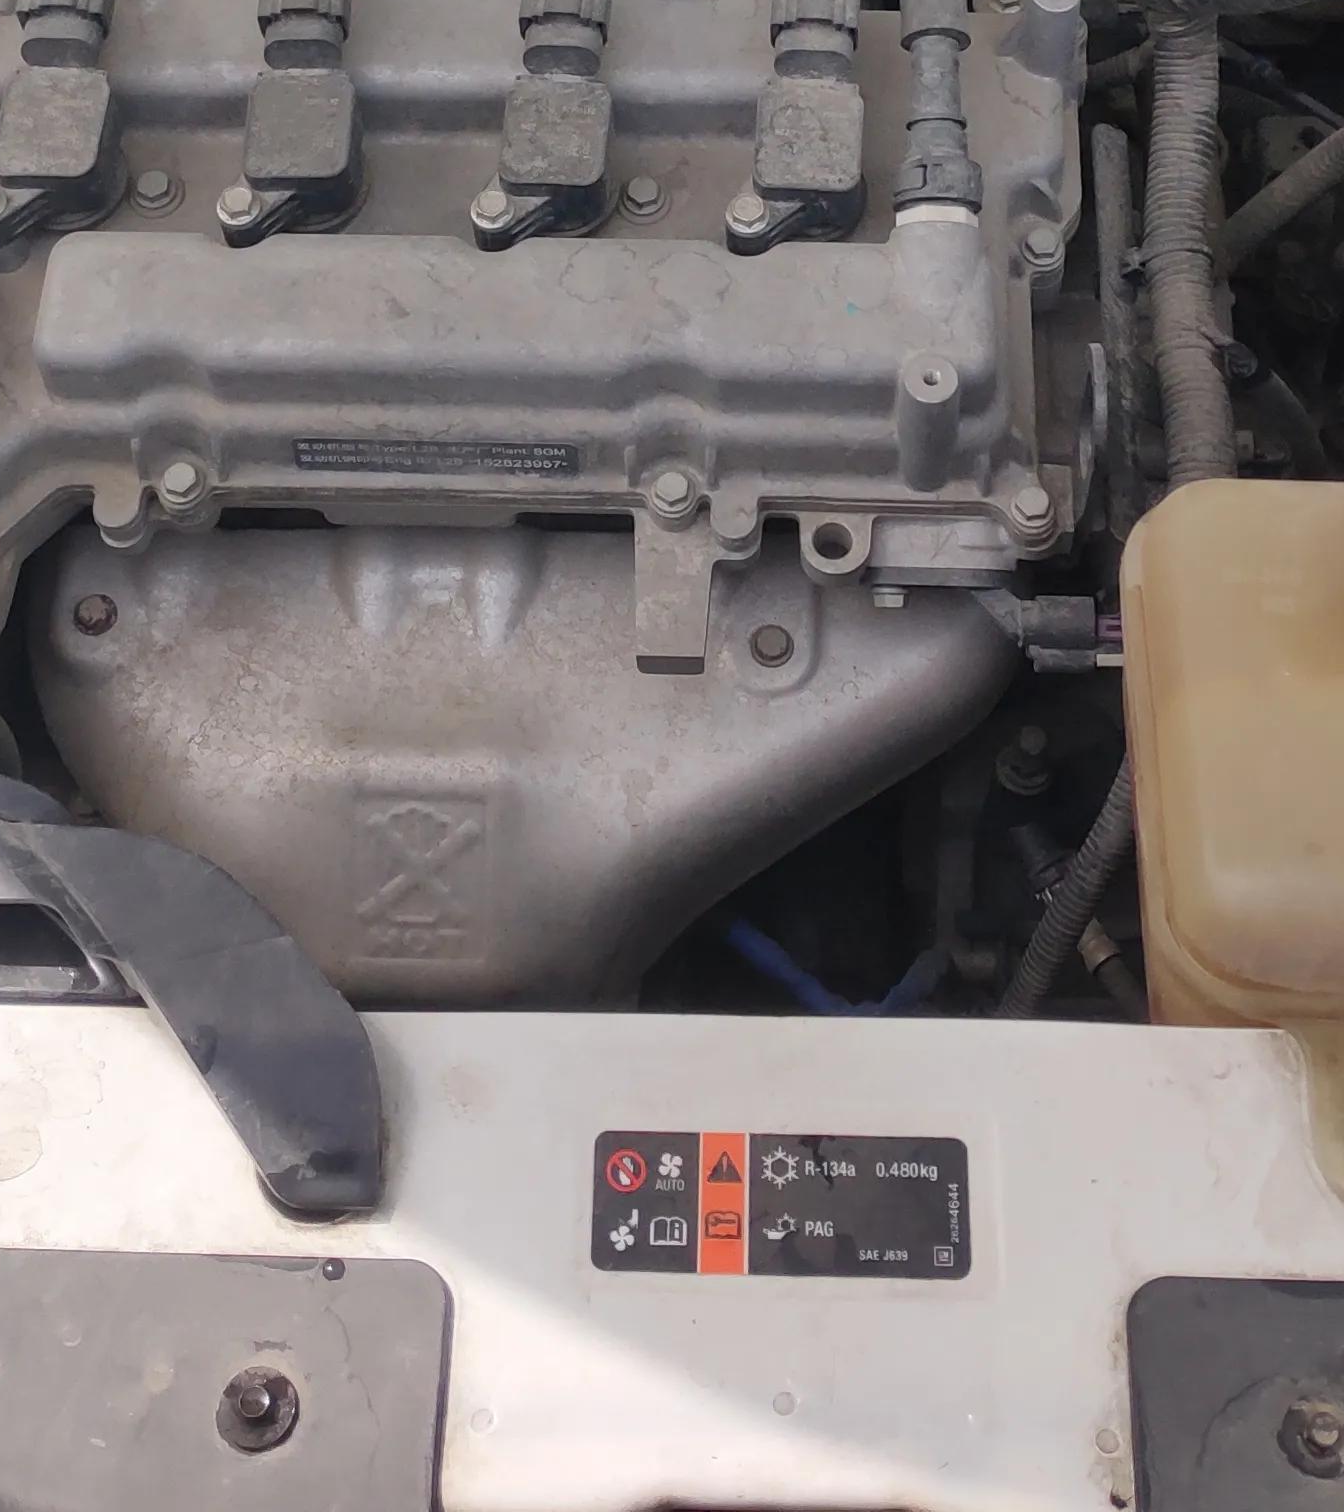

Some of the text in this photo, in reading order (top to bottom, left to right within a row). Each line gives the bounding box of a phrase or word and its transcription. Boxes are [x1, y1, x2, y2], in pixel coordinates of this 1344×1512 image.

[491, 446, 529, 456] Plant
[804, 1161, 938, 1181] R-134a 0.480kg
[655, 1178, 685, 1192] AUTO
[804, 1221, 834, 1238] PAG
[859, 1249, 908, 1262] SAE J639
